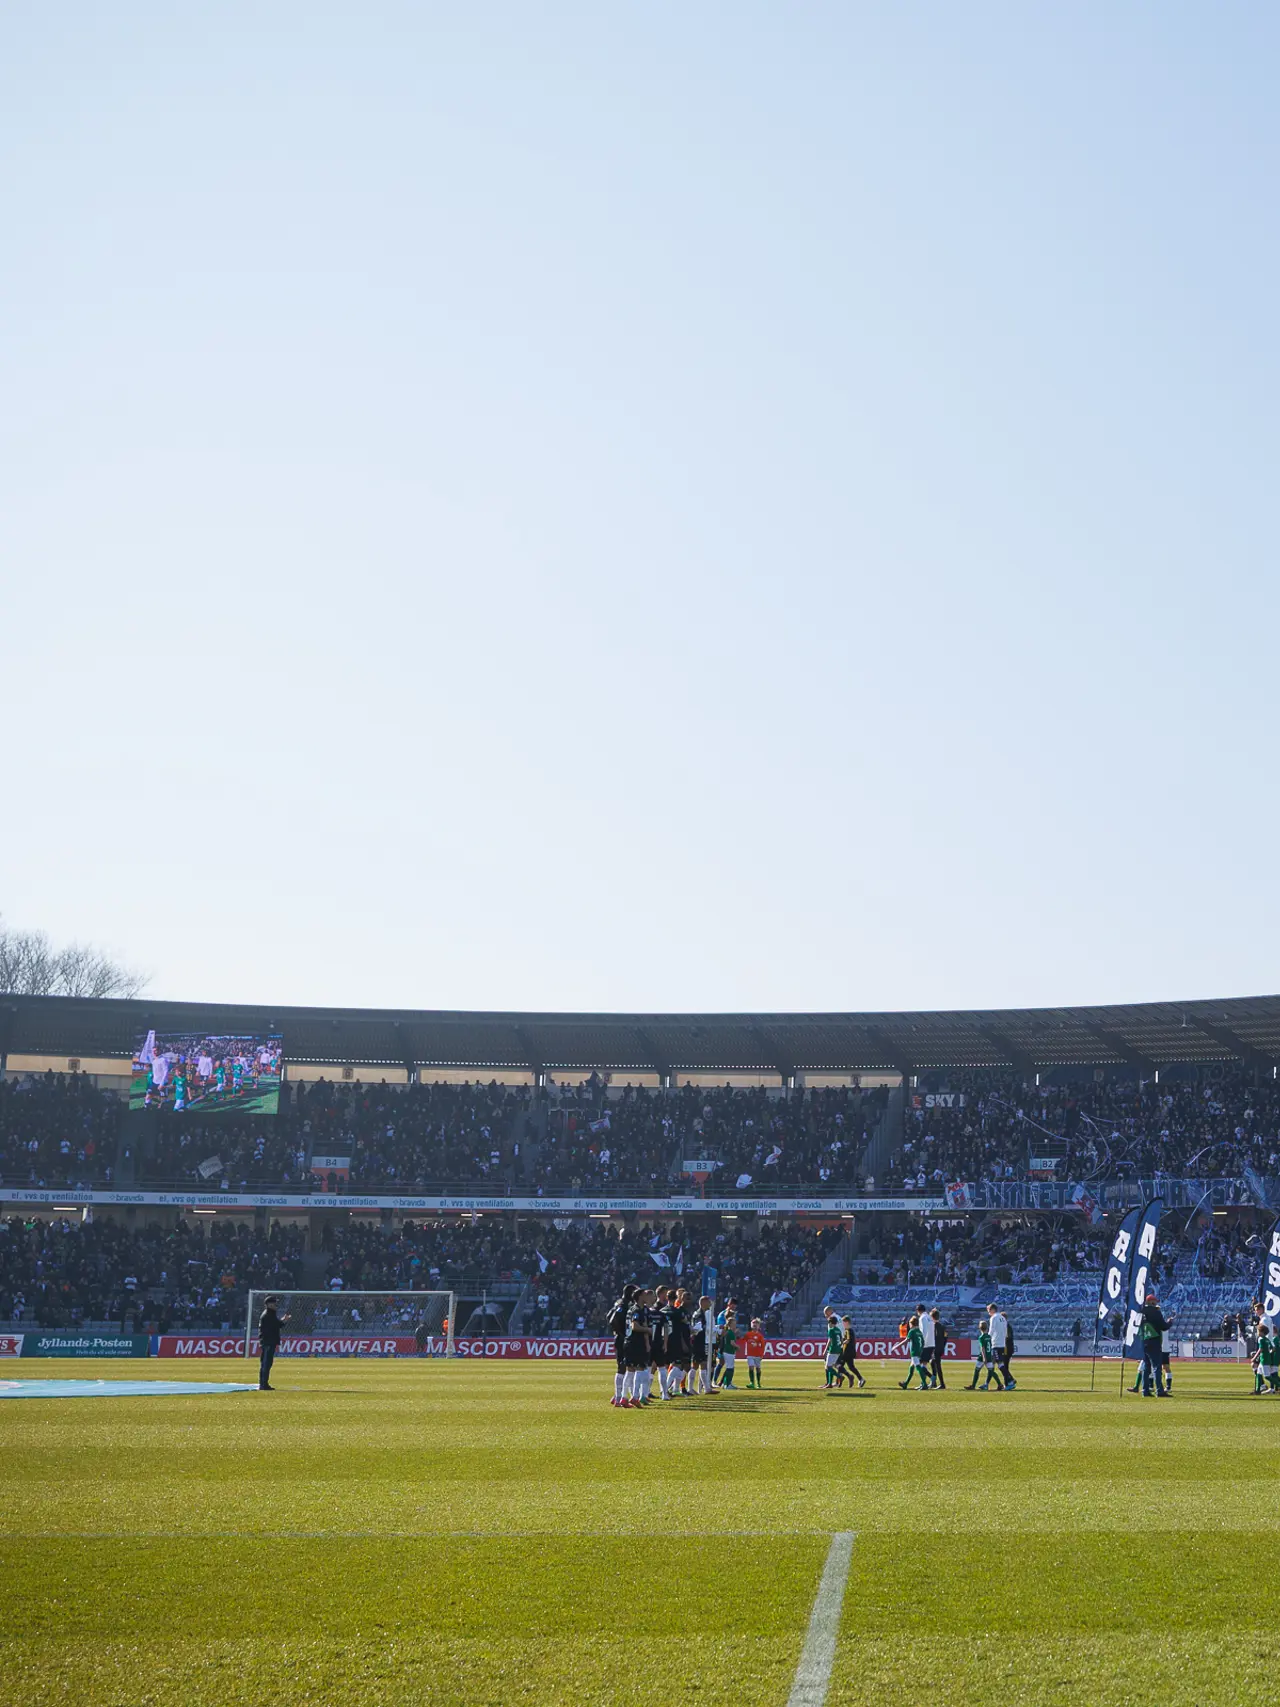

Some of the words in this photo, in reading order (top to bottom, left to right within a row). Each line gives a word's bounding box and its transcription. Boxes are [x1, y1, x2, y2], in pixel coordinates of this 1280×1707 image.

[325, 1158, 337, 1167] B4
[696, 1162, 708, 1170] B3
[1042, 1160, 1053, 1168] B2
[1125, 1222, 1156, 1347] AGF
[38, 1338, 133, 1349] Jyllands-Posten
[278, 1340, 397, 1354] WORKWEAR
[526, 1341, 615, 1356] WORKWE
[744, 1341, 827, 1357] ASCOT
[1041, 1342, 1074, 1355] bravida
[1201, 1343, 1233, 1355] bravida
